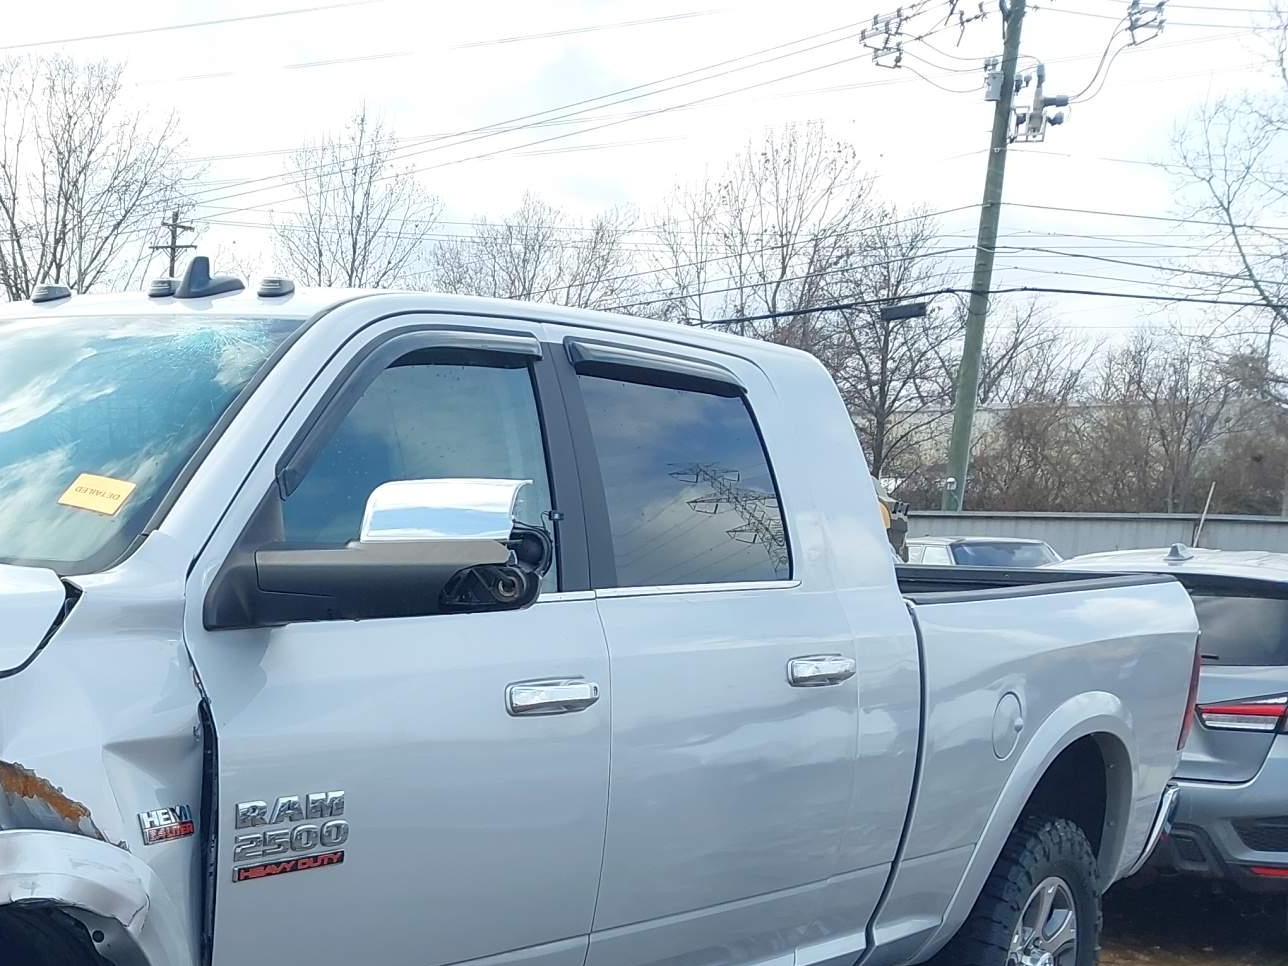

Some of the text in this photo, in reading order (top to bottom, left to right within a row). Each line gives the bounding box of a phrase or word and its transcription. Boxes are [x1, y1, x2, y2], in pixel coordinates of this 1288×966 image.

[75, 486, 121, 501] DETAILED
[140, 805, 192, 829] HEMI
[235, 790, 345, 830] RAM
[233, 819, 350, 862] 2500
[239, 852, 342, 880] HEAVY DUTY
